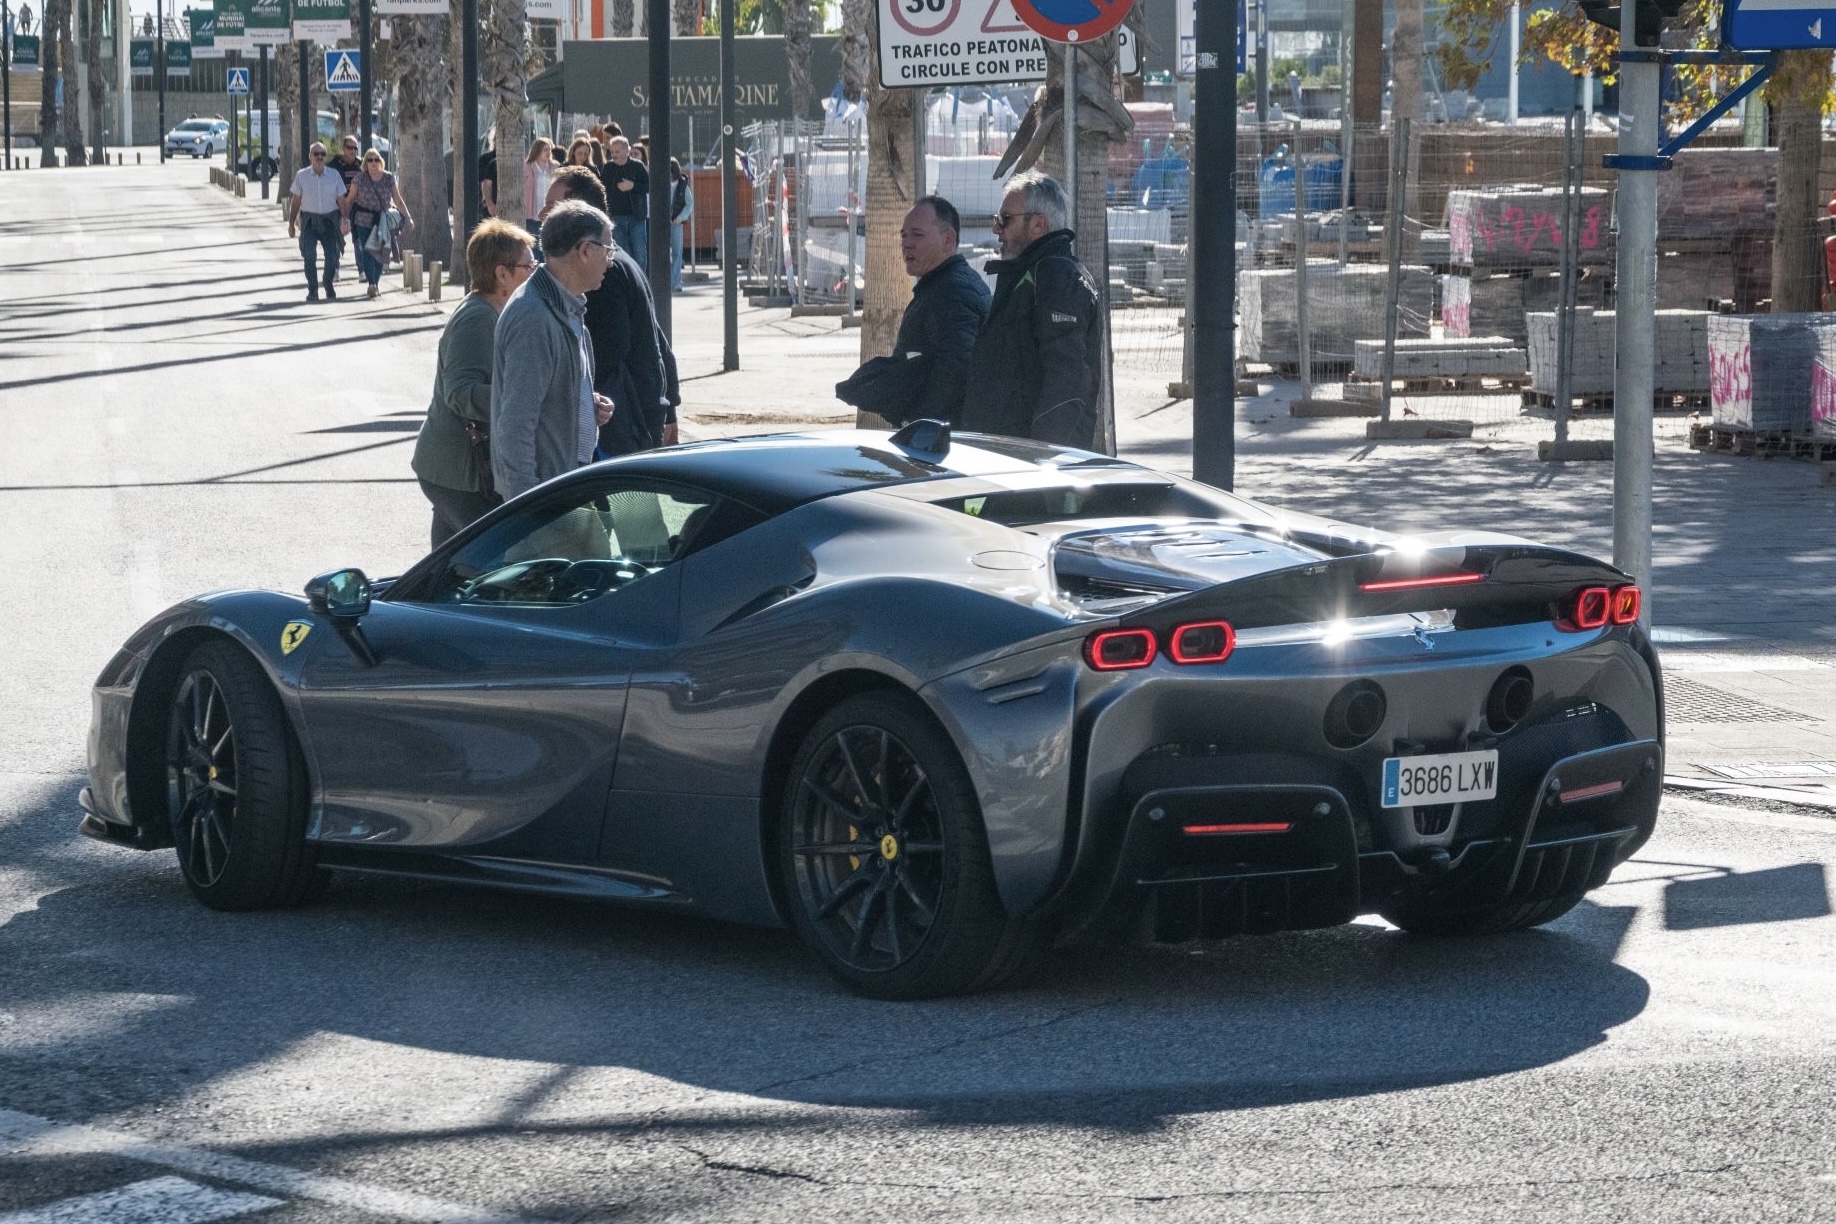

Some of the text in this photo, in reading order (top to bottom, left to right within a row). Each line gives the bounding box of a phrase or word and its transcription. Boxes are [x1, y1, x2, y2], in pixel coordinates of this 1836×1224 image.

[892, 42, 961, 59] TRAFICO
[967, 38, 1042, 55] PEATONA
[901, 57, 1047, 79] CIRCULE CON PRE
[1400, 760, 1496, 796] 3686 LXW
[1387, 786, 1395, 798] E
